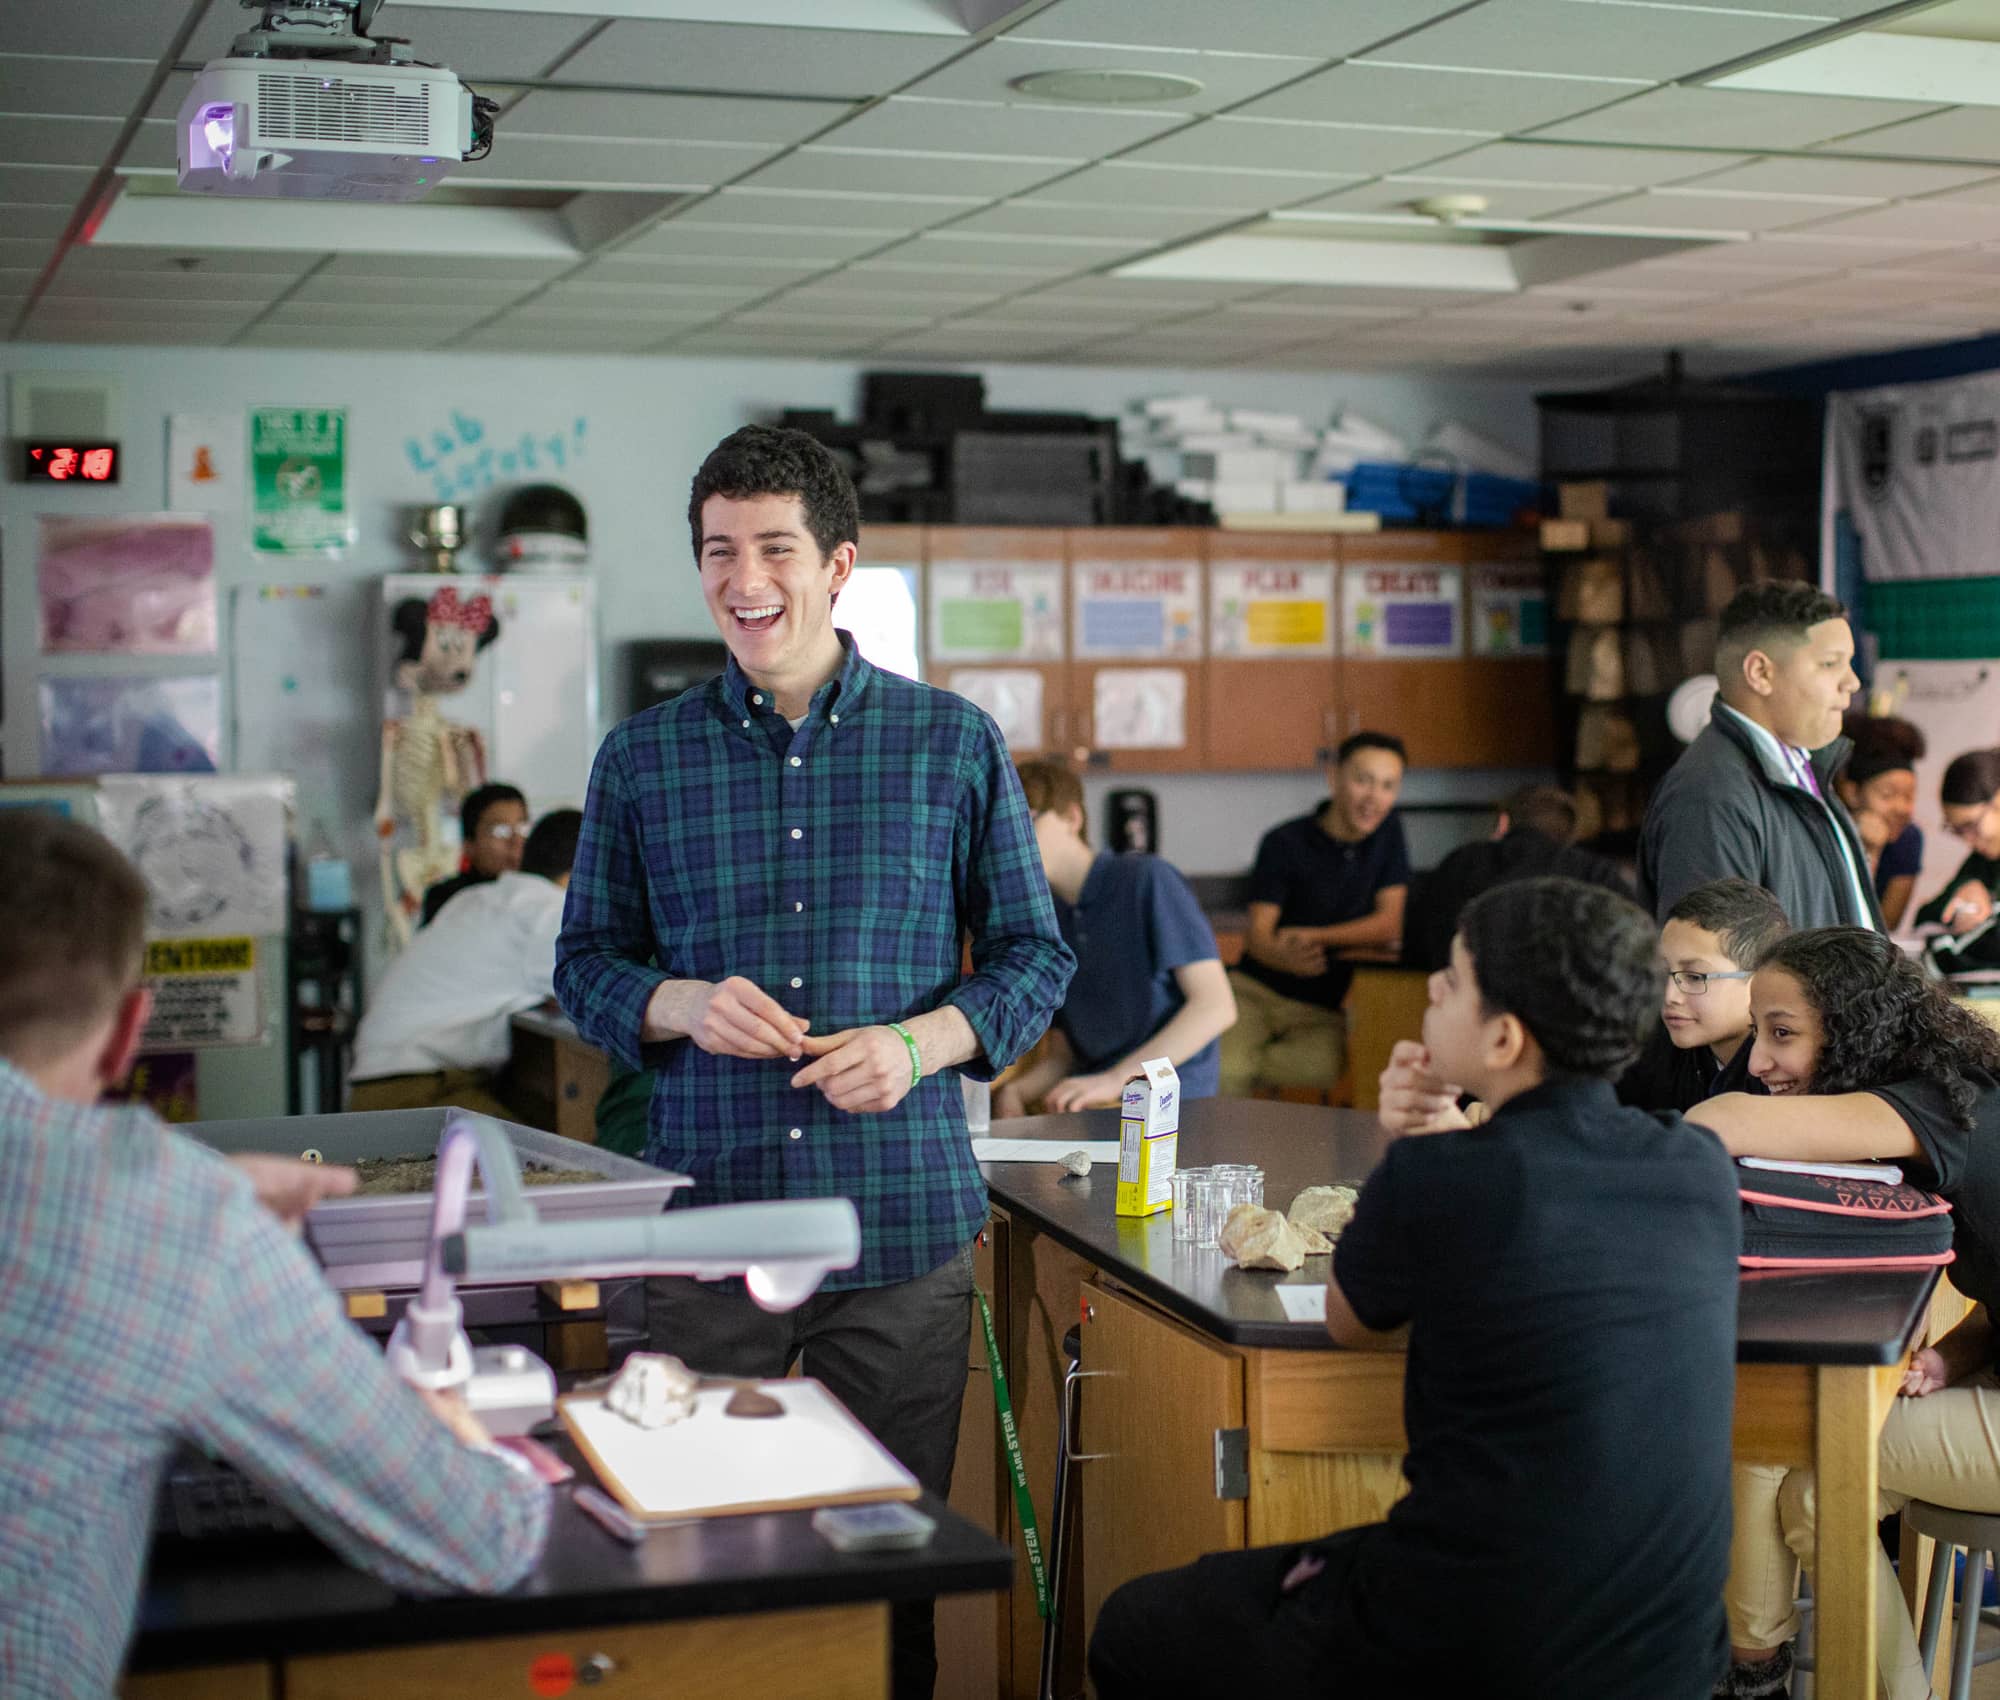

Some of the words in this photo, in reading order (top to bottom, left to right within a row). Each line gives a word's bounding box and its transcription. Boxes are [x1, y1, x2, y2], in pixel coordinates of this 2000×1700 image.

[1363, 570, 1440, 594] CREATE
[149, 943, 249, 969] ENTION!
[1002, 1410, 1018, 1450] STEM
[1013, 1451, 1025, 1472] ARE
[1018, 1472, 1027, 1487] WE
[1024, 1526, 1041, 1564] STEM
[1034, 1565, 1047, 1585] ARE
